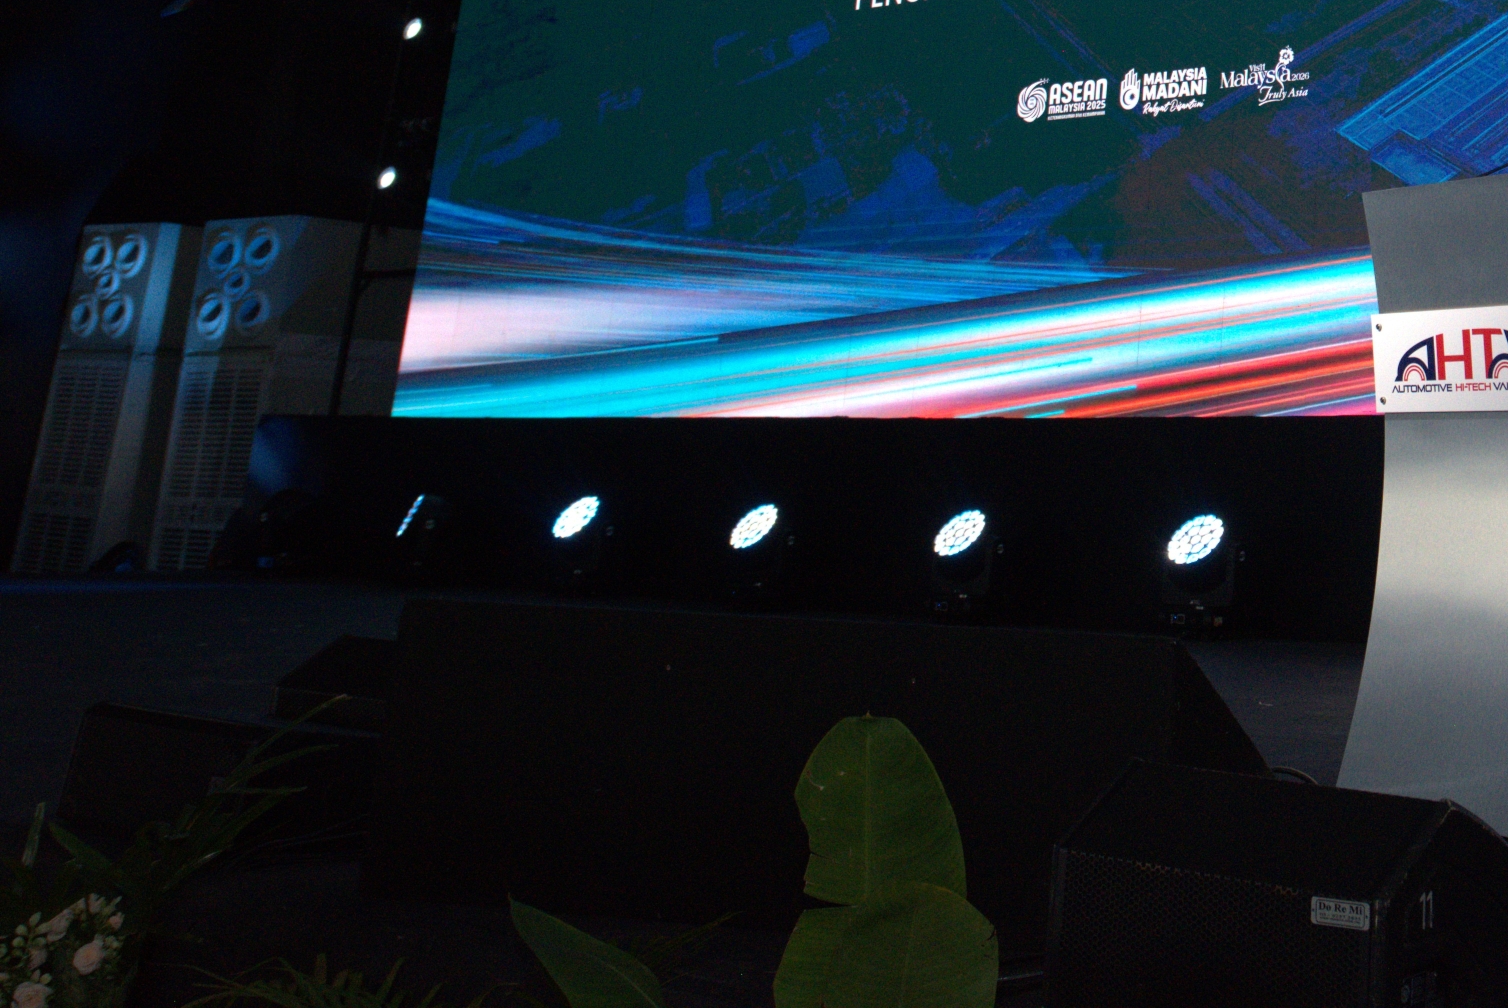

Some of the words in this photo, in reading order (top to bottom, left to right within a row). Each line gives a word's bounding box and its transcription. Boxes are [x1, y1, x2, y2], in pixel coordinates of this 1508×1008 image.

[1143, 66, 1208, 85] MALAYSIA
[1220, 63, 1291, 89] Malaysia
[1291, 72, 1310, 81] 2026
[1249, 63, 1266, 72] Visit
[1049, 78, 1108, 105] ASEAN
[1142, 79, 1208, 102] MADANI
[1258, 86, 1287, 105] Truly
[1288, 87, 1308, 98] Asia
[1048, 101, 1085, 114] MALAYSIA
[1086, 100, 1106, 111] 2025
[1391, 383, 1453, 394] AUTOMOTIVE
[1455, 382, 1492, 392] HI-TECH
[1318, 901, 1332, 912] Do
[1334, 903, 1347, 914] Re
[1350, 905, 1363, 916] Mi
